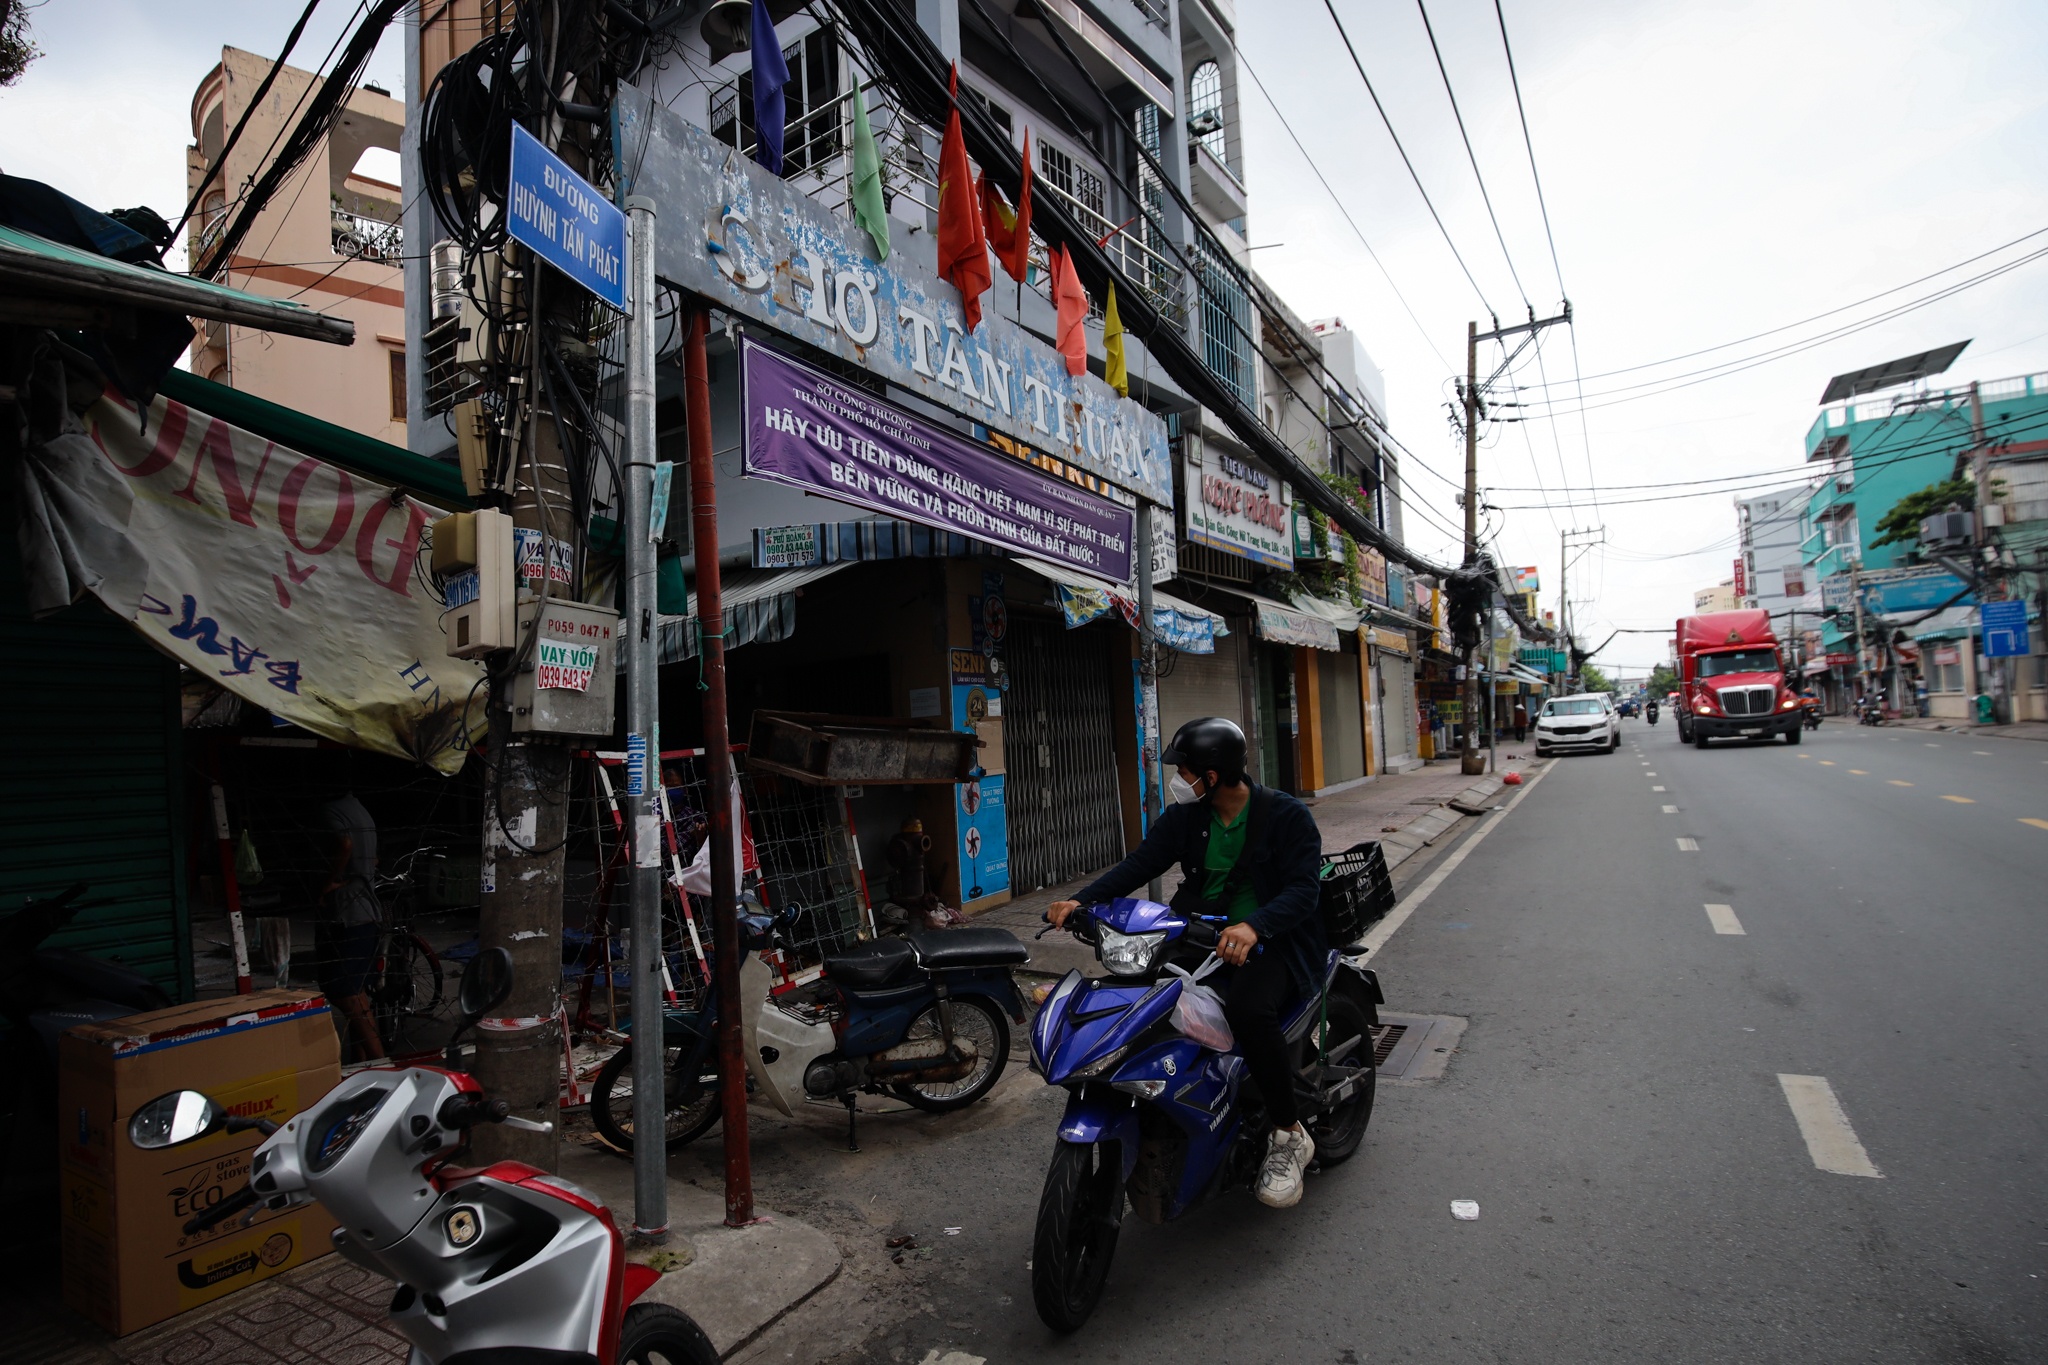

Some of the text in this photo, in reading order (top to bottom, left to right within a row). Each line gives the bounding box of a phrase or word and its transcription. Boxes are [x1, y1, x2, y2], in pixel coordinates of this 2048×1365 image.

[544, 163, 599, 225] ĐƯỜNG
[514, 182, 620, 286] HUỲNH TẤN PHÁT
[900, 304, 1012, 417] TÂN
[816, 380, 912, 430] SỞ CÔNG THƯƠNG
[792, 388, 930, 451] THÀNH PHỐ HỒ CHÍ MINH
[764, 406, 809, 439] HÃY
[816, 424, 842, 452] ƯU
[848, 436, 890, 469] TIÊN
[895, 454, 938, 487] DÙNG
[942, 472, 980, 503] HÀNG
[984, 488, 1012, 513] VIỆT
[1016, 500, 1040, 523] NAM
[1044, 508, 1054, 528] VÌ
[1057, 516, 1072, 536] SỰ
[1073, 521, 1097, 544] PHÁT
[1099, 532, 1125, 554] TRIỂN
[830, 460, 870, 492] BỀN
[874, 476, 920, 508] VỮNG
[922, 492, 944, 516] VÀ
[948, 502, 985, 529] PHỒN
[988, 516, 1017, 539] VINH
[1020, 524, 1043, 548] CỦA
[1045, 534, 1066, 555] ĐẤT
[1068, 542, 1094, 566] NƯỚC
[1192, 512, 1204, 528] Mua
[766, 550, 814, 564] 0903 077 579
[1736, 560, 1744, 596] HOTEL
[548, 618, 610, 639] P059 047 H
[540, 644, 566, 664] VAY
[538, 665, 560, 688] 0939
[562, 668, 578, 689] 643
[50, 1011, 95, 1020] HONDA
[1209, 1102, 1230, 1132] YAMAHA
[1064, 1128, 1084, 1137] YAMAHA
[216, 1156, 240, 1172] gas
[216, 1164, 250, 1183] stove
[173, 1185, 224, 1218] ECO
[208, 1268, 233, 1284] Inline
